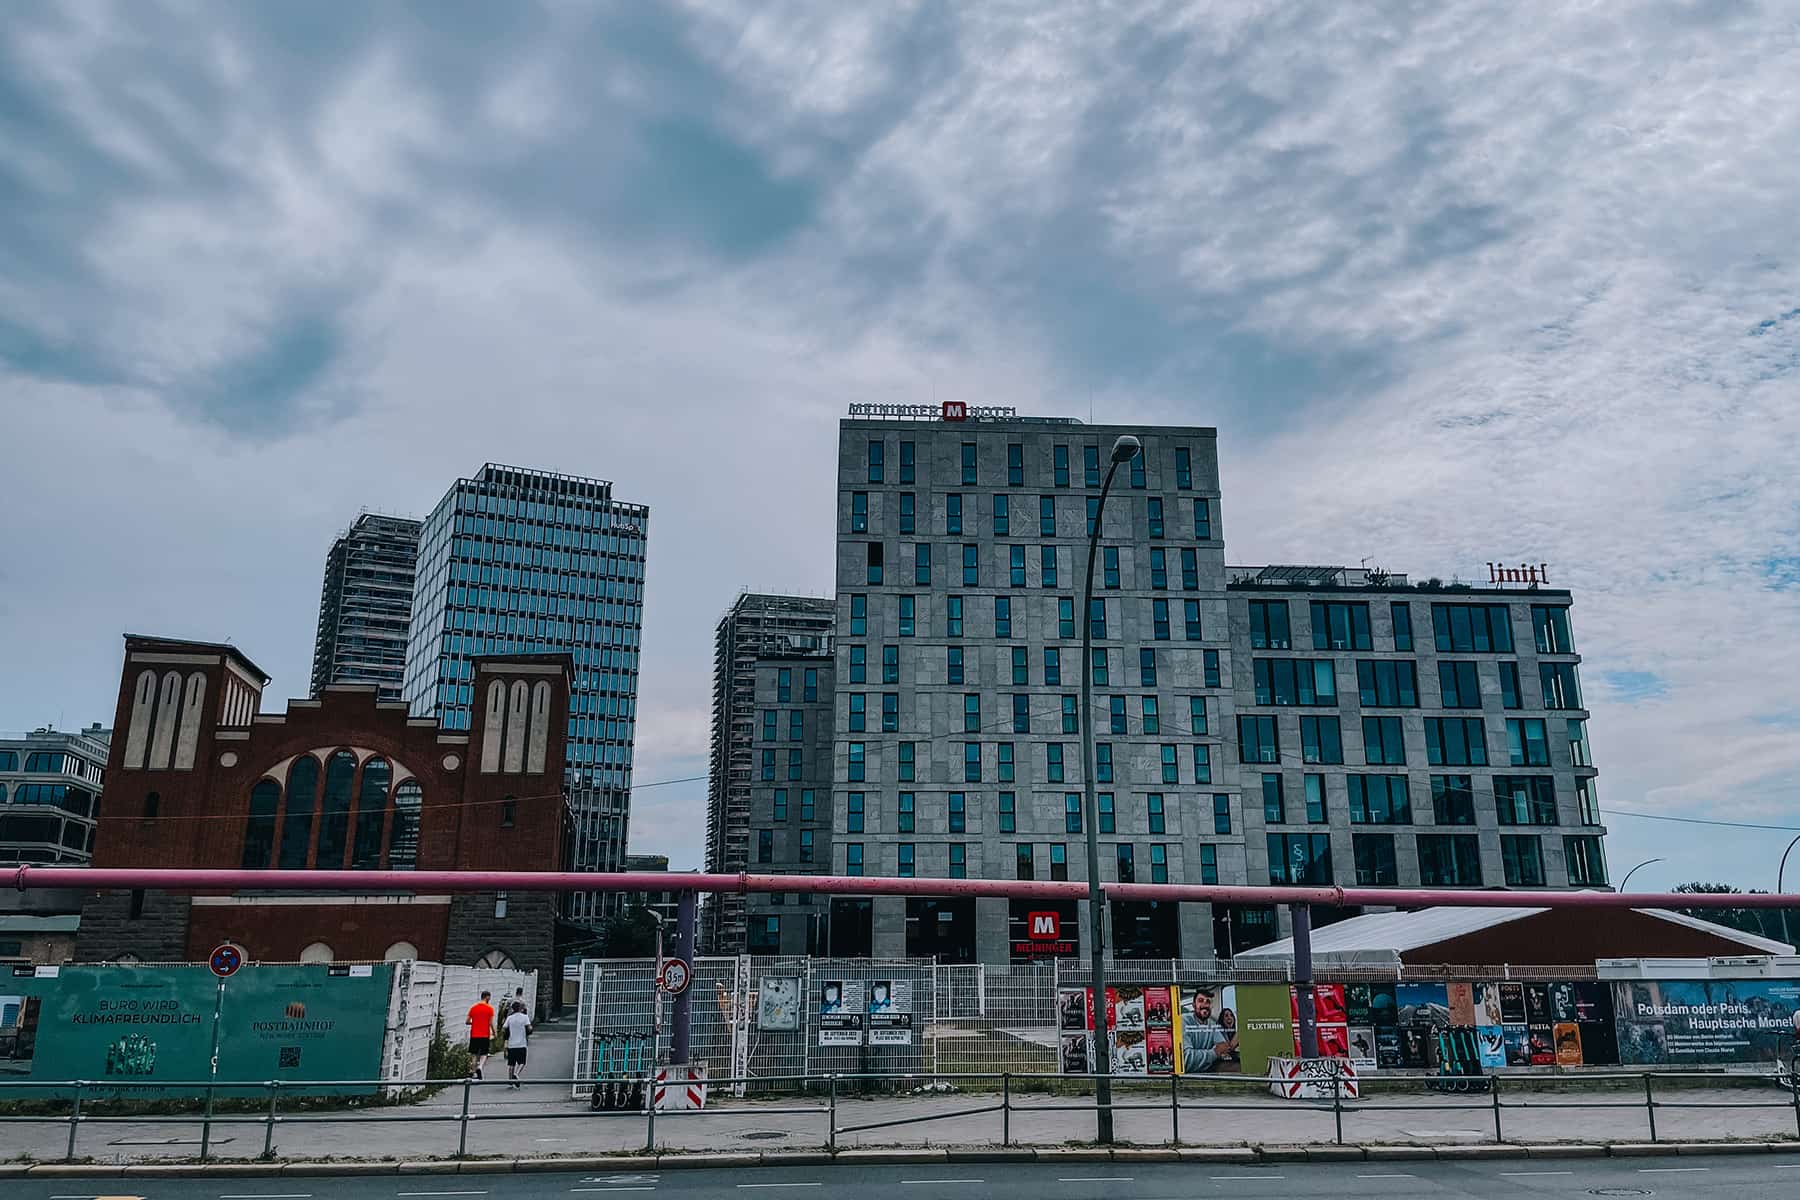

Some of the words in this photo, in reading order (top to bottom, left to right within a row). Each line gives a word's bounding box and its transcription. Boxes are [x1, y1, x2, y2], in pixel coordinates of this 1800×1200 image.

[848, 403, 940, 416] MEININGER
[946, 405, 963, 417] M
[970, 406, 1016, 417] HOTEL
[1034, 916, 1055, 934] M
[1016, 943, 1072, 953] MEININGER
[143, 1000, 178, 1010] WIRD
[1638, 1003, 1689, 1015] Potsdam
[1691, 1003, 1717, 1014] oder
[1720, 1002, 1752, 1014] Paris.
[72, 1014, 201, 1024] KLIMAFREUNDLICH
[1689, 1017, 1756, 1031] Hauptsache
[1758, 1016, 1793, 1028] Monet
[252, 1021, 336, 1032] POSTBAHNHOF
[1247, 1022, 1285, 1031] FLIXTRAIN
